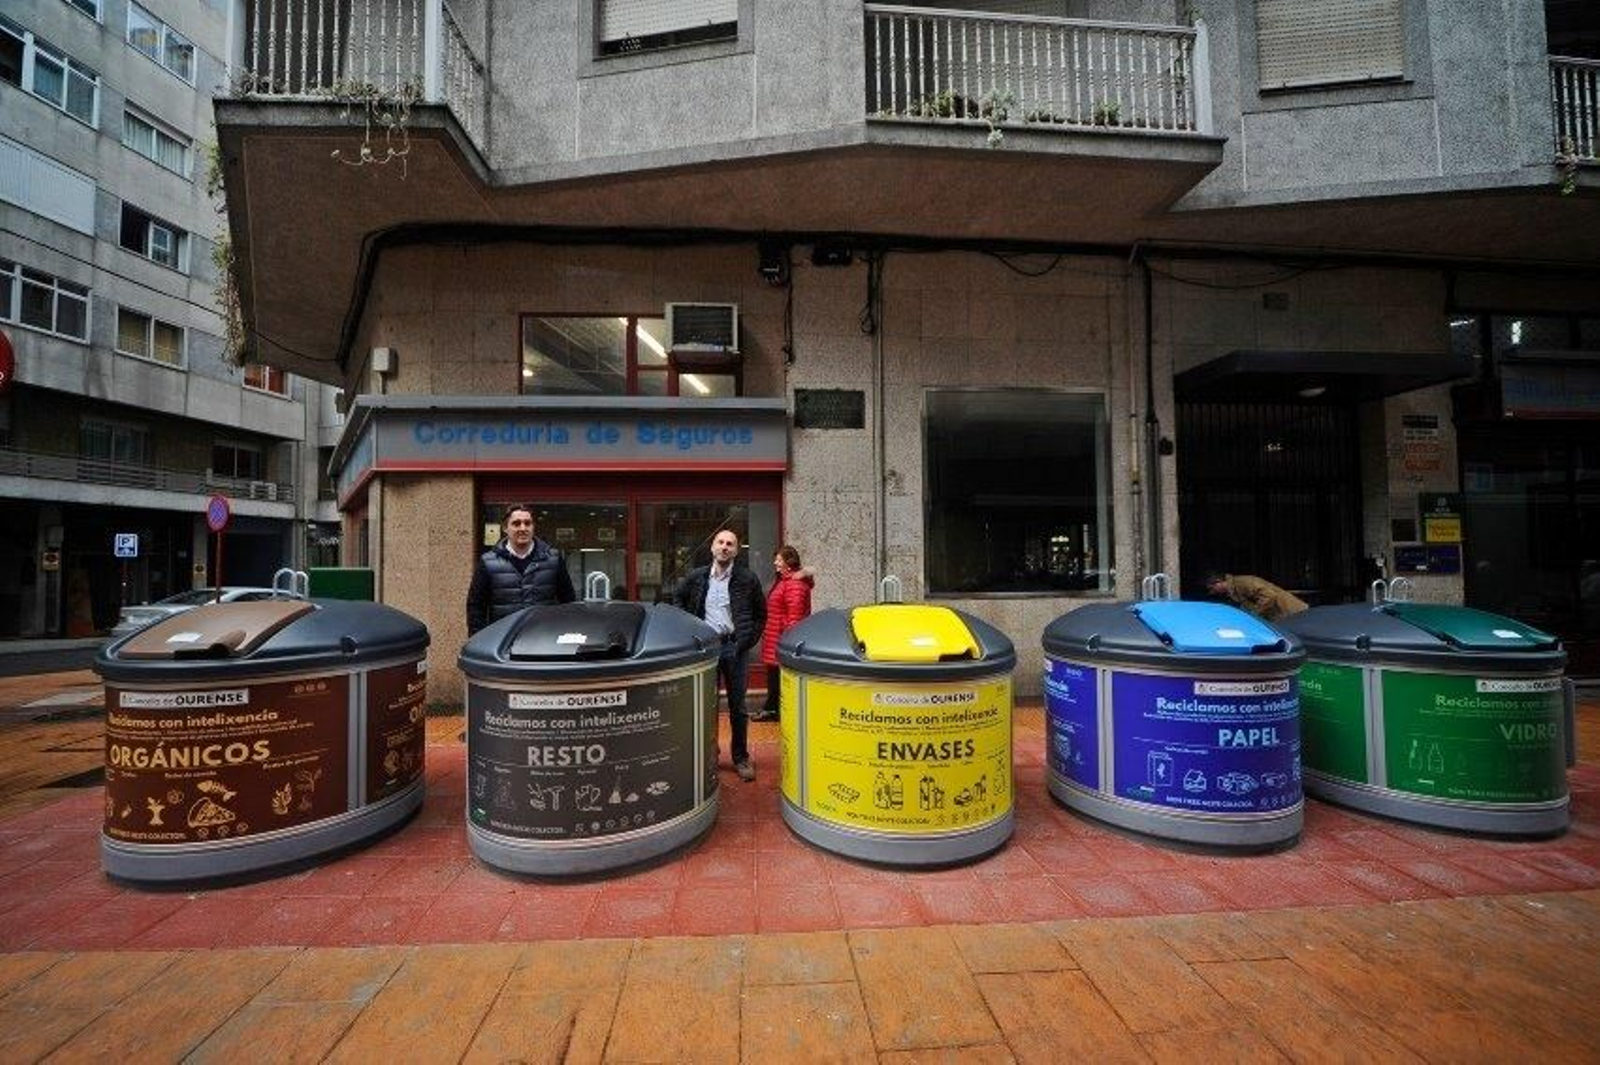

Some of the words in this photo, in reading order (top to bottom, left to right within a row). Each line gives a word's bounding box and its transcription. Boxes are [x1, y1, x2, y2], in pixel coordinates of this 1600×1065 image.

[586, 421, 620, 445] de
[636, 421, 753, 450] Seguros
[121, 537, 130, 546] P
[175, 691, 244, 706] OURENSE
[567, 693, 623, 706] OURENSE
[1157, 697, 1237, 713] Reciclamos
[1239, 703, 1261, 713] con
[1435, 694, 1519, 708] Reciclamos
[159, 717, 184, 729] con
[186, 708, 279, 727] intelixencia
[484, 710, 547, 729] Reciclamos
[550, 718, 576, 729] con
[580, 706, 661, 728] intelixencia
[840, 707, 912, 725] Reciclamos
[916, 714, 940, 725] con
[1218, 728, 1280, 747] PAPEL
[1499, 723, 1558, 741] VIDRO
[110, 740, 270, 769] ORGÁNICOS
[527, 744, 606, 767] RESTO
[877, 739, 975, 761] ENVASES
